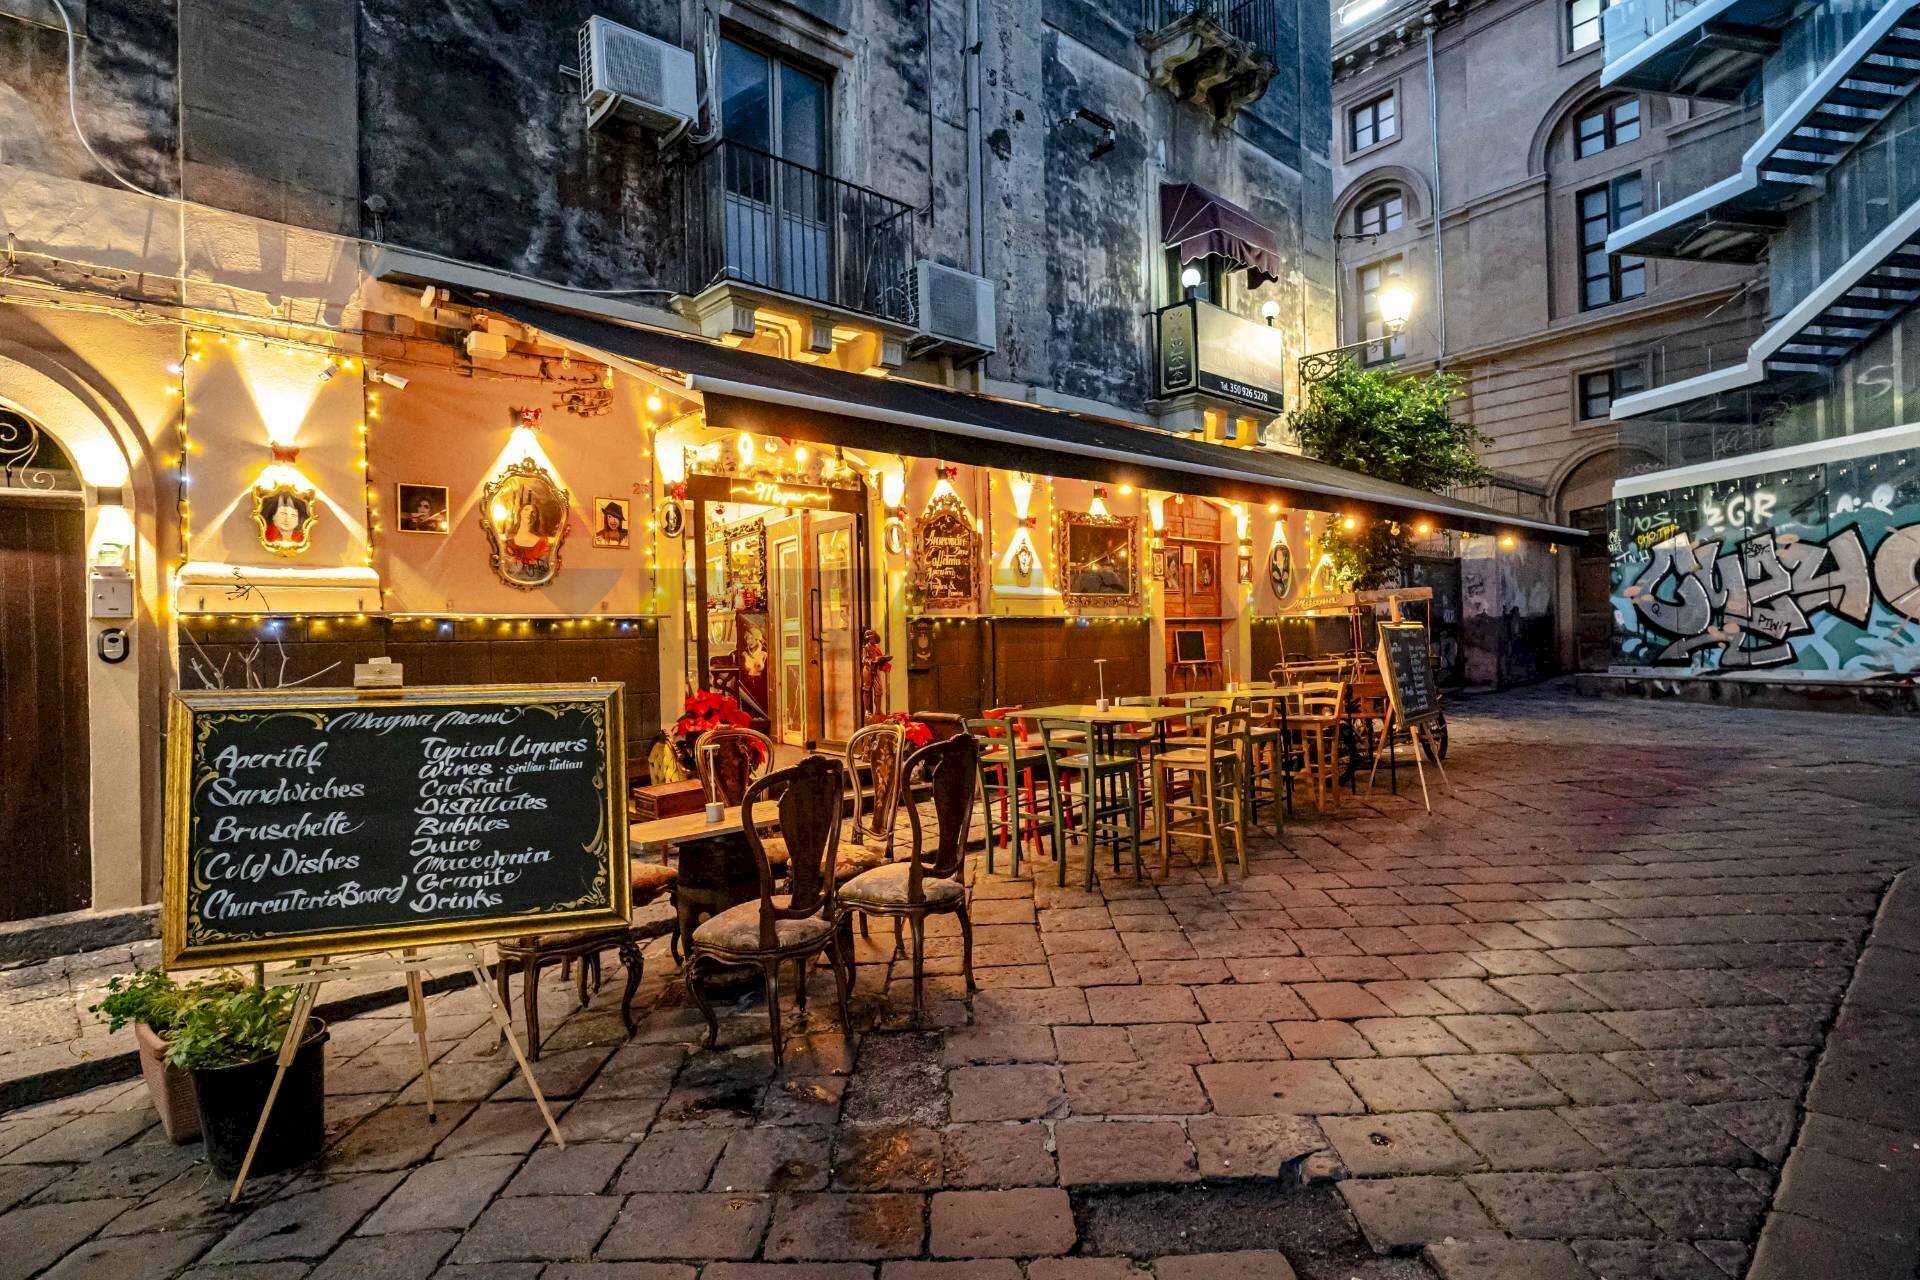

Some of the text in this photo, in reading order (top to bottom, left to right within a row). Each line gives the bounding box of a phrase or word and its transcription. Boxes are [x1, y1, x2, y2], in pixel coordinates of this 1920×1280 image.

[1220, 381, 1268, 402] Tel. 350 926 5278
[212, 741, 329, 778] Aperitif
[420, 734, 589, 767] Typical Liquers
[418, 761, 494, 779] Wines
[208, 777, 365, 807] Sandwiches
[209, 811, 366, 843] Bruschette
[414, 815, 510, 836] Bubbles
[409, 836, 482, 857] Juice
[205, 848, 361, 883] Cold Dishes
[412, 847, 553, 875] Macedonia
[335, 875, 408, 909] Board
[416, 867, 522, 894] Granite
[409, 889, 503, 913] Drinks
